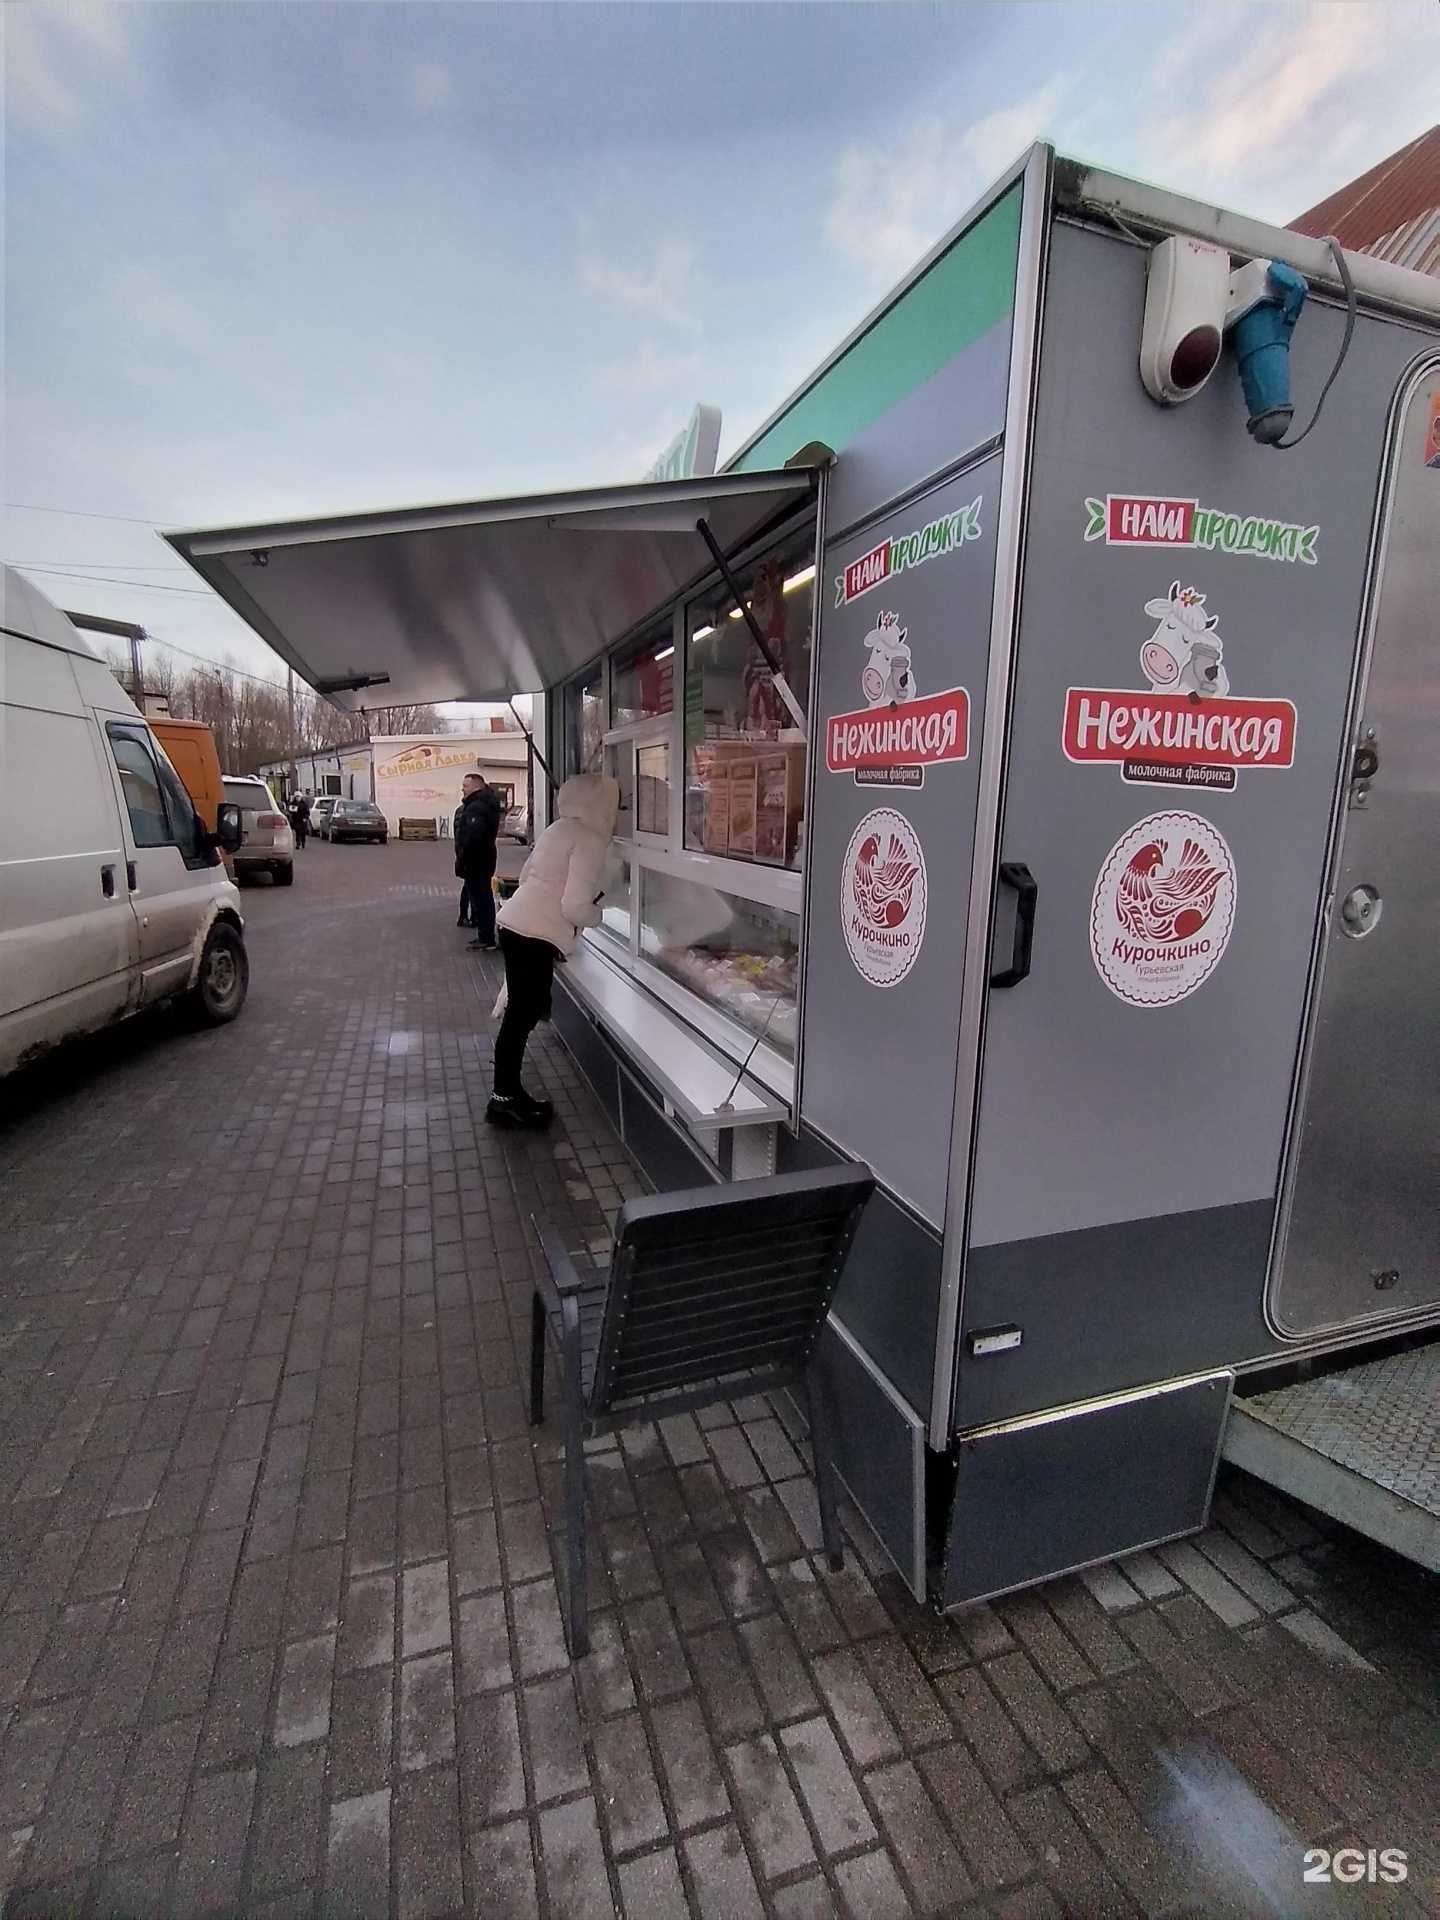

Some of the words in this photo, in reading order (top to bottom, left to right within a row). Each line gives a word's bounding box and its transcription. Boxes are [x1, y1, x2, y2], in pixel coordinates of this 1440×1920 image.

[851, 549, 886, 592] НАШ
[889, 512, 965, 572] ПРОДУКТ
[1121, 503, 1185, 540] НАШ
[1193, 511, 1299, 560] ПРОДУКТ
[832, 709, 958, 762] Нежинская
[1077, 698, 1282, 761] Нежинская
[1128, 764, 1183, 780] молочная
[1185, 764, 1232, 784] фабрика
[851, 914, 911, 948] Курочкино
[1111, 937, 1212, 965] Курочкино
